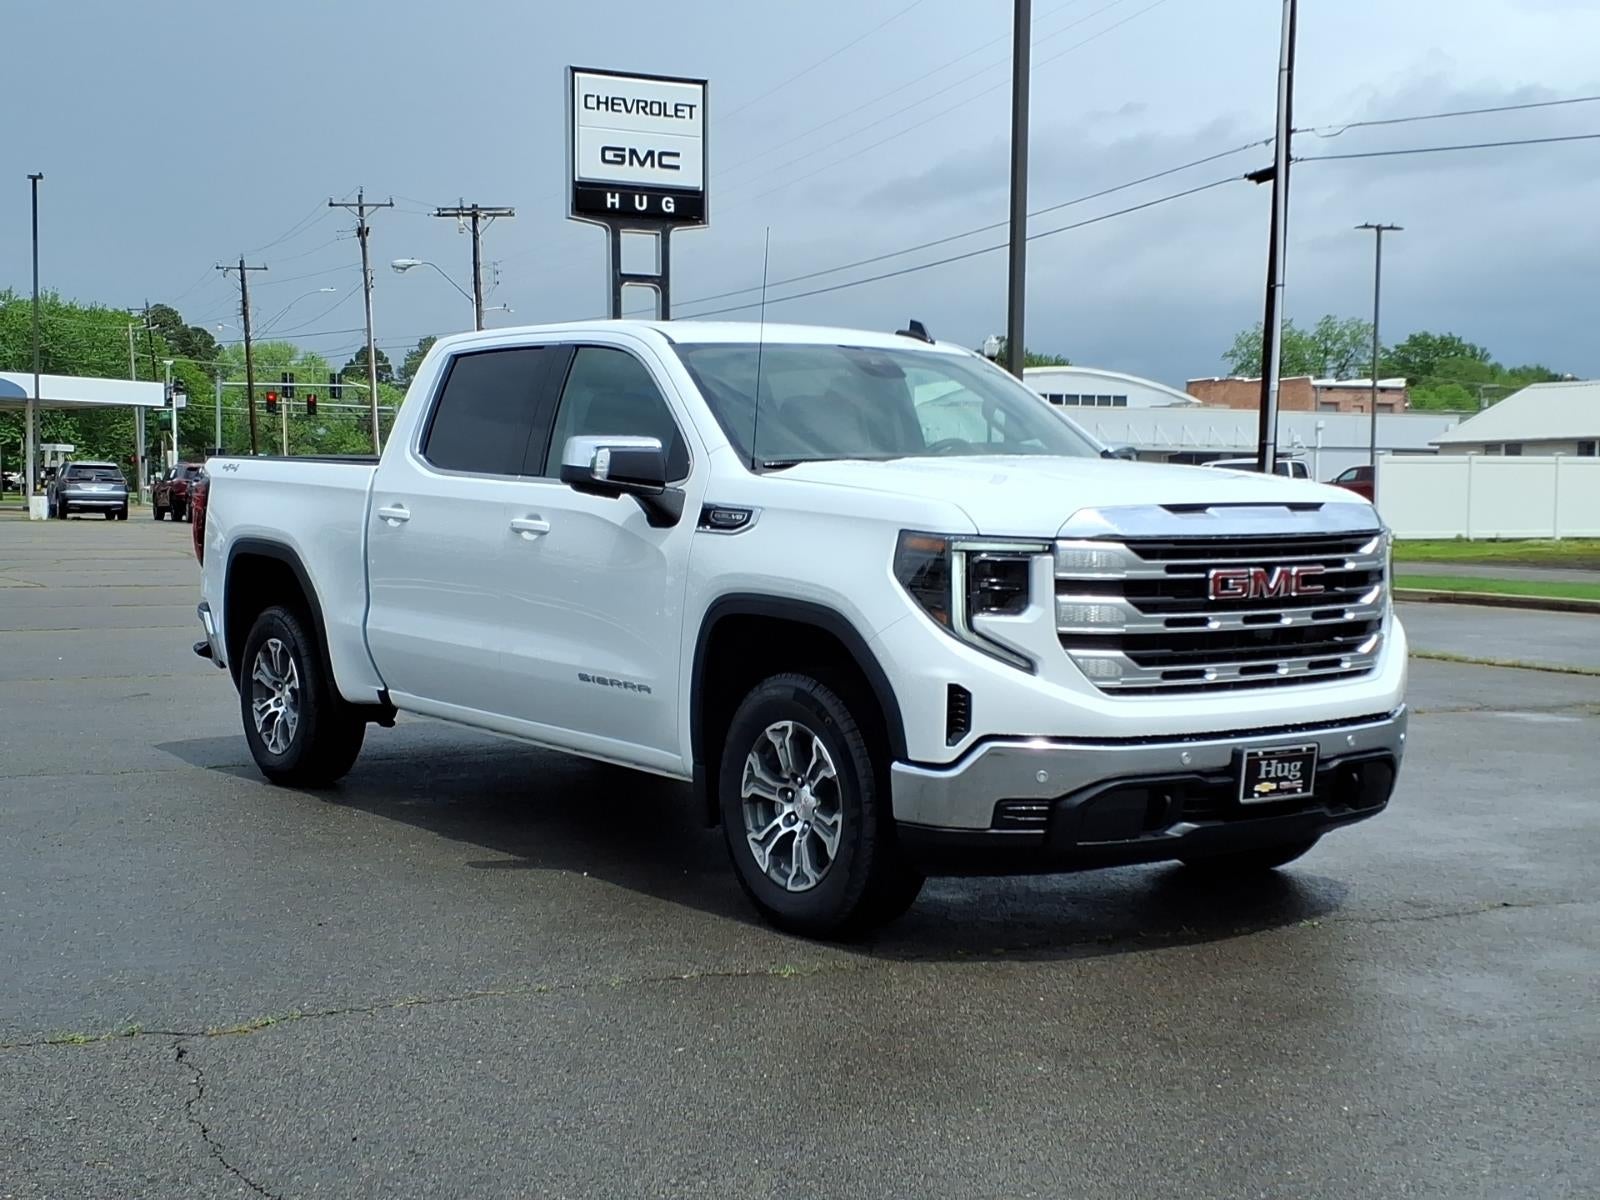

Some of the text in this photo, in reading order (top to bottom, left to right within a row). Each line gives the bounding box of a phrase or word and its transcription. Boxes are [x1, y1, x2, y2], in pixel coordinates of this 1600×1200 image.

[584, 93, 697, 120] CHEVROLET
[600, 145, 681, 171] GMC
[606, 192, 675, 213] HUG
[1208, 566, 1325, 600] GMC
[578, 672, 651, 694] SIERRA
[1257, 759, 1303, 780] Hug
